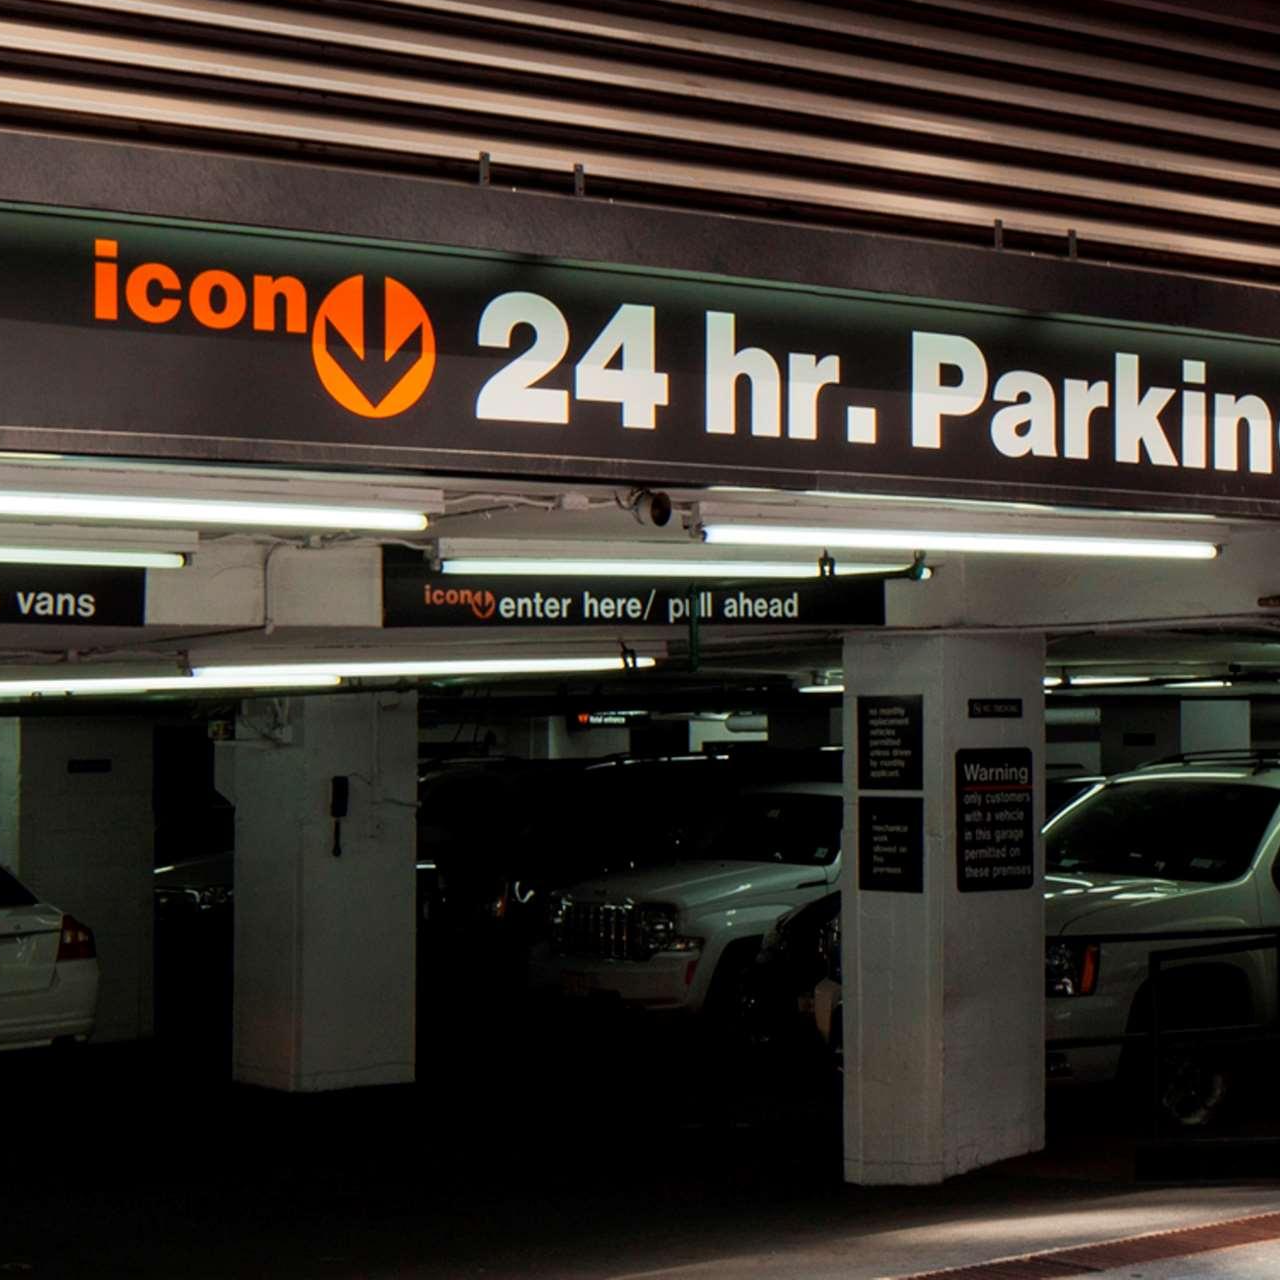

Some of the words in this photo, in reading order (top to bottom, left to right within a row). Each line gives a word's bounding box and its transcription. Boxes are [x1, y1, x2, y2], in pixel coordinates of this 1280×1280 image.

[94, 238, 308, 334] icon
[475, 291, 669, 430] 24
[705, 310, 877, 445] hr.
[16, 591, 96, 617] vans
[424, 584, 472, 606] icon
[499, 592, 572, 619] enter
[723, 591, 799, 618] ahead
[963, 763, 1029, 784] Warning
[985, 792, 1031, 805] customers
[994, 808, 1025, 822] vehicle
